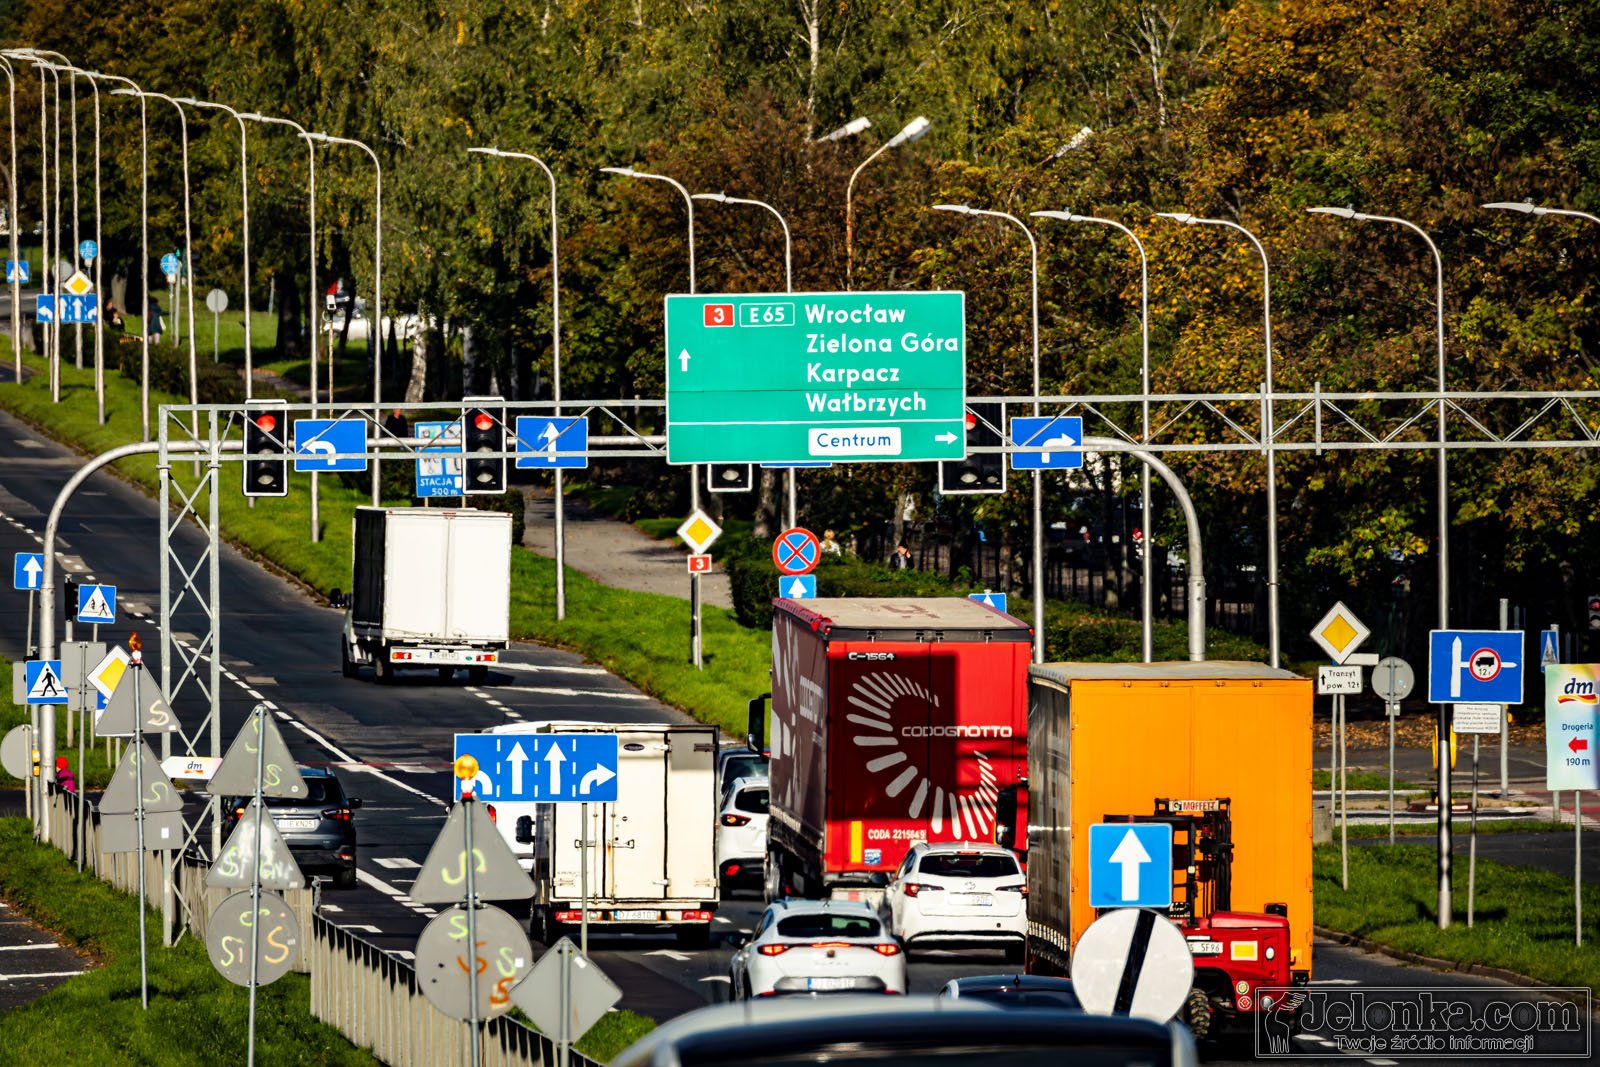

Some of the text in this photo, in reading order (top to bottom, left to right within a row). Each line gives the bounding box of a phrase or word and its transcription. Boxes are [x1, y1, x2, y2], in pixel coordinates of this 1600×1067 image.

[713, 307, 725, 323] 3
[805, 303, 906, 324] Wrocław
[806, 331, 959, 353] Zielona Góra
[807, 363, 900, 388] Karpacz
[806, 391, 927, 417] Wałbrzych
[816, 432, 891, 448] Centrum
[420, 478, 452, 487] STACJA
[431, 488, 449, 496] 500
[696, 558, 704, 570] 3
[848, 652, 895, 661] C-1564
[1564, 677, 1594, 694] dm
[901, 726, 1013, 738] CODOGNOTTO
[1562, 722, 1594, 732] Drogeria
[187, 761, 202, 770] dm
[1566, 757, 1591, 766] 190 m
[867, 828, 890, 840] CODA
